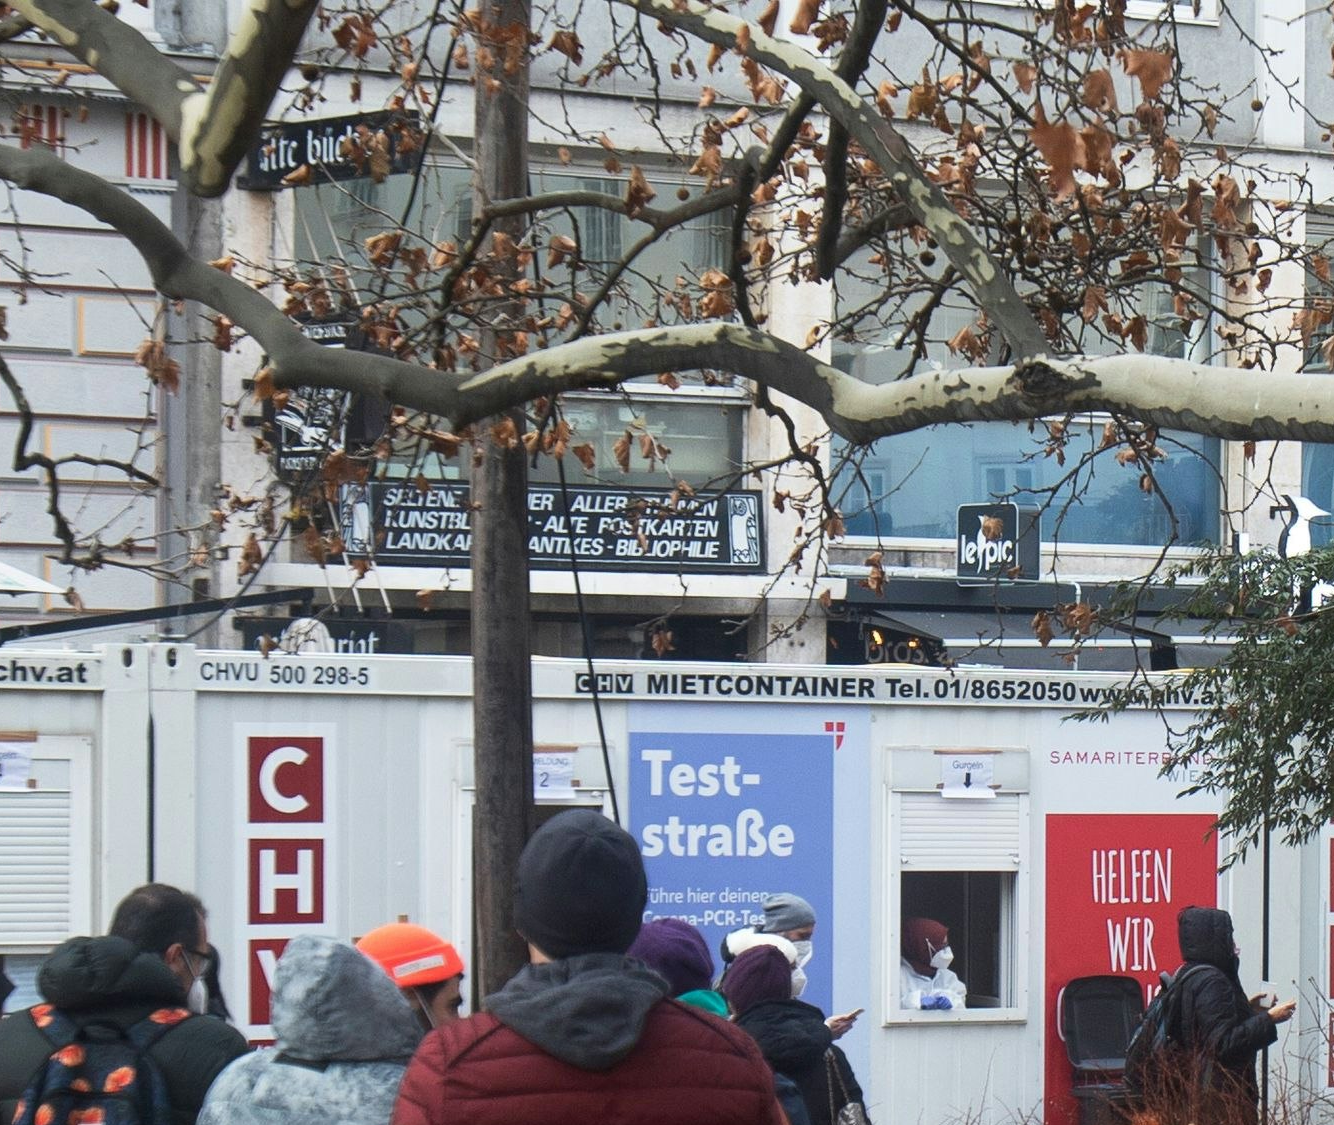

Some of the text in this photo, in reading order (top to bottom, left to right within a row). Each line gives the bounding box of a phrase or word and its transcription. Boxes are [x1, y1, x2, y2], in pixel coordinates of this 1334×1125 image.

[384, 510, 471, 529] KUNSTBL
[543, 515, 589, 533] ALTE
[385, 532, 473, 551] LANDKA
[199, 661, 370, 687] CHVU 500 298-5
[575, 673, 633, 695] CHV
[647, 673, 876, 699] MIETCONTAINER
[885, 677, 930, 699] Tel.
[933, 679, 1076, 704] 01/8652050
[539, 771, 550, 788] 2
[641, 749, 761, 797] Test-
[1167, 770, 1200, 783] WIE
[641, 808, 795, 857] straße
[1091, 848, 1172, 904] HELFEN
[647, 887, 683, 905] ühre
[687, 887, 716, 904] hier
[1107, 916, 1157, 973] WIR
